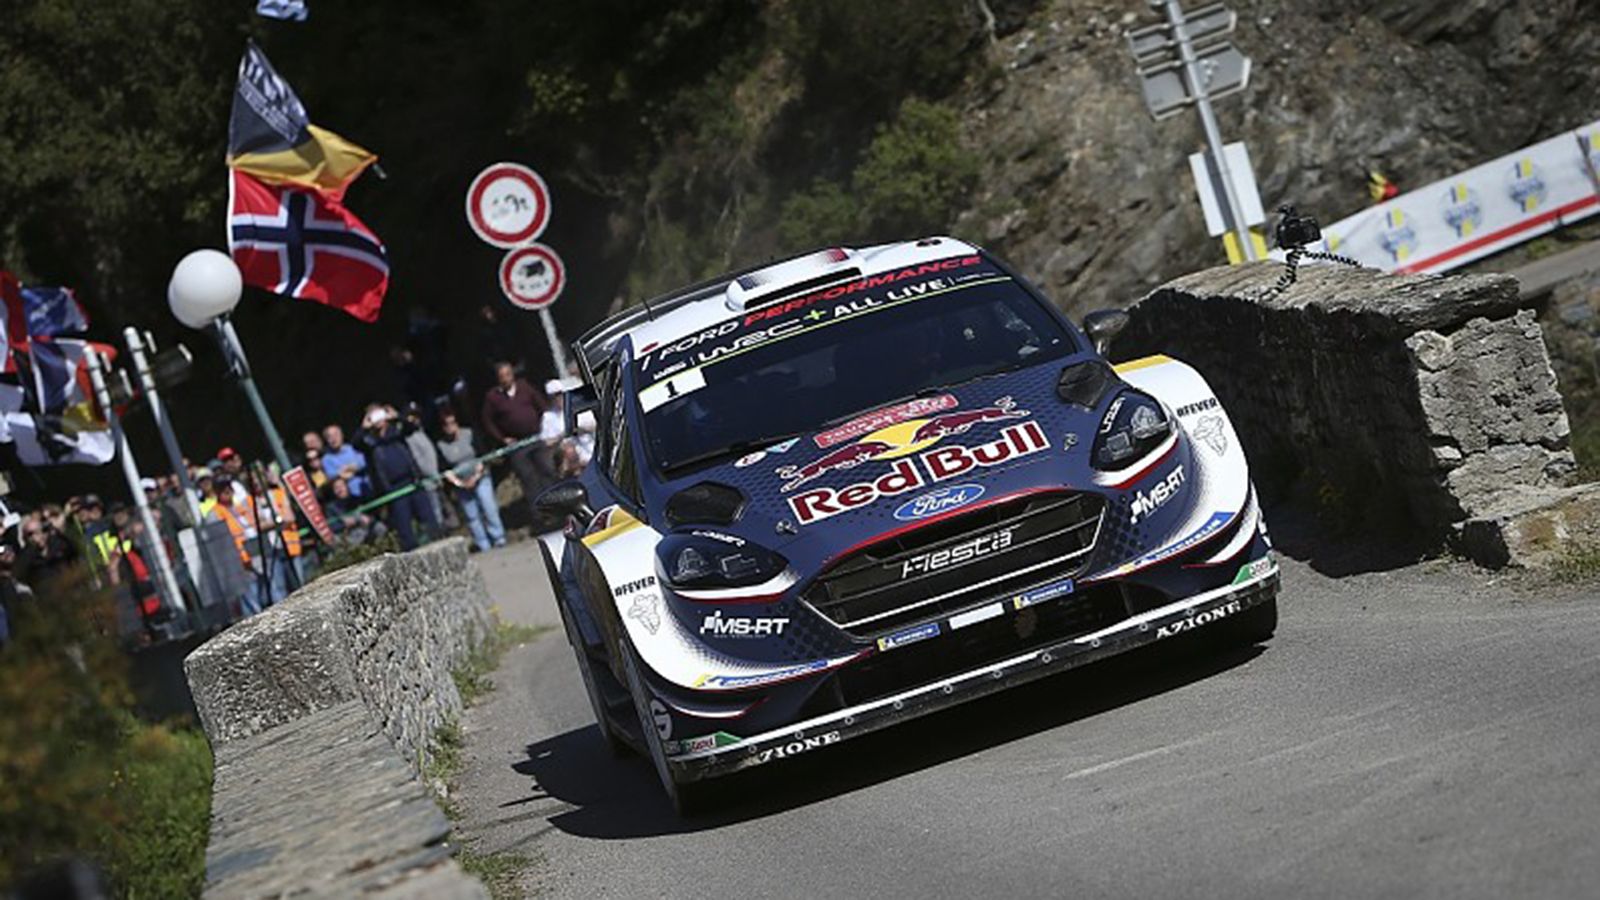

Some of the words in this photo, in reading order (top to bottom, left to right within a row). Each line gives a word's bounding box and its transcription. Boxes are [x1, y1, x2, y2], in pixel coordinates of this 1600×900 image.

[659, 320, 740, 361] FORD
[743, 255, 982, 327] PERFORMANCE
[833, 297, 884, 318] ALL
[886, 277, 948, 302] LIVE
[664, 380, 679, 399] 1
[789, 460, 922, 525] Red
[922, 421, 1050, 482] Bull
[912, 489, 967, 515] Ford
[901, 529, 1014, 579] Fiesta
[713, 617, 790, 635] MS-RT
[1156, 600, 1242, 639] AZIONE
[744, 730, 841, 767] ZIONE
